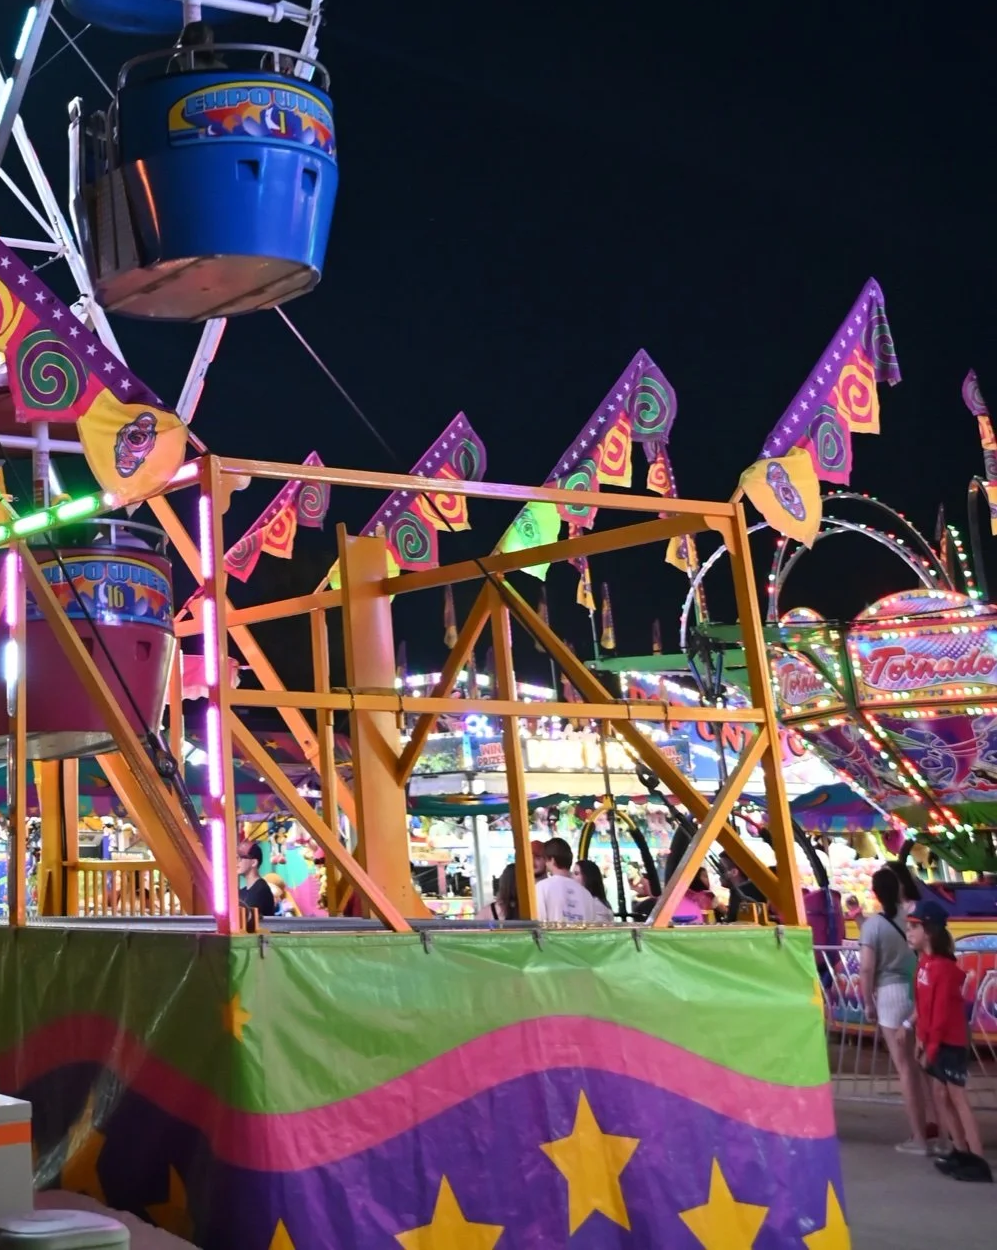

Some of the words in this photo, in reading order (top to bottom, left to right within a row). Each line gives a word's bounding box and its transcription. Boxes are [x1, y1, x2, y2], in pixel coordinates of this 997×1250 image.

[41, 561, 104, 584] XPO
[107, 584, 124, 608] 16
[867, 646, 996, 685] Tornado
[479, 742, 503, 756] WIN
